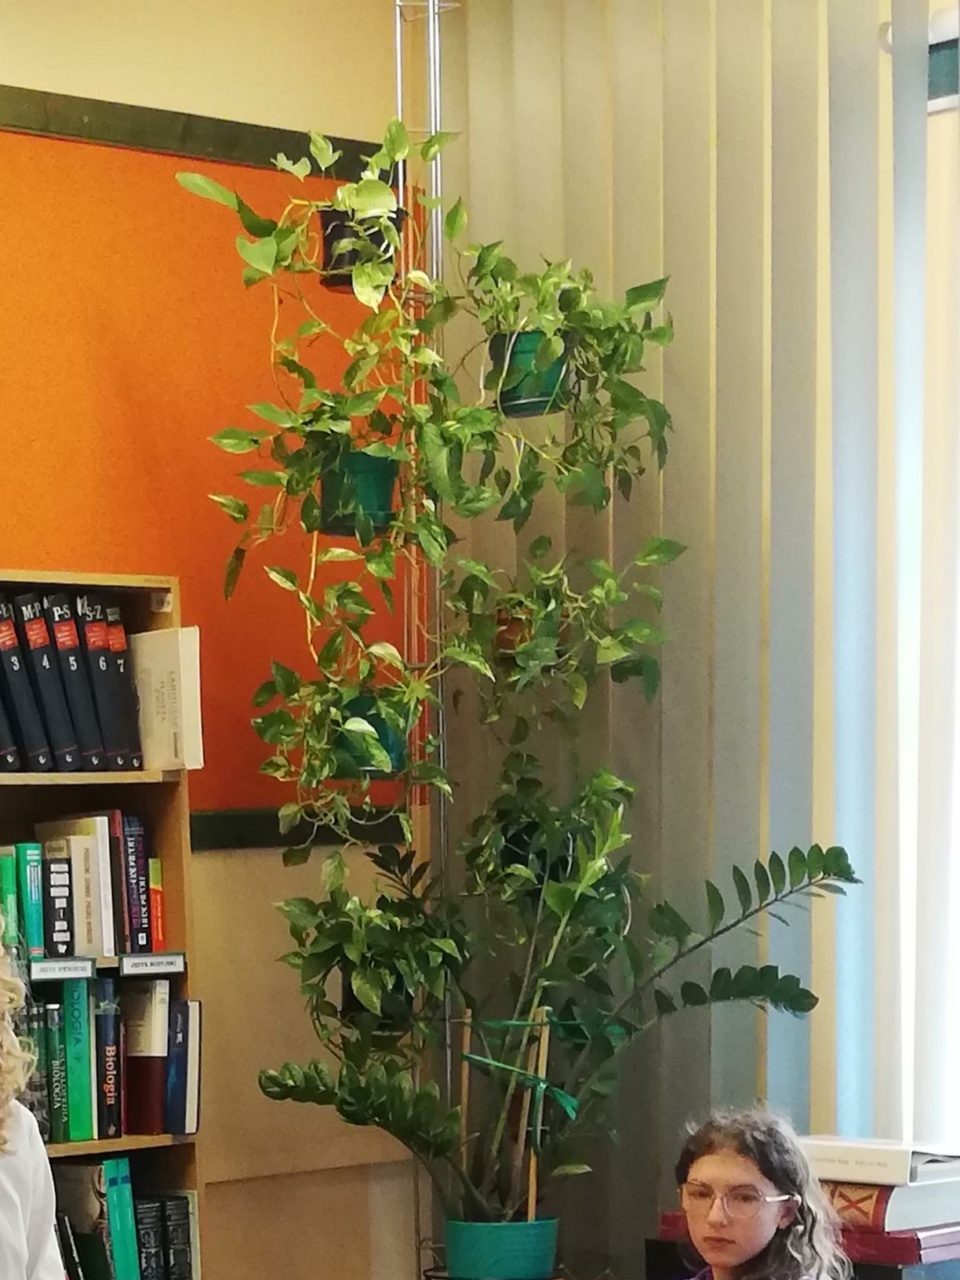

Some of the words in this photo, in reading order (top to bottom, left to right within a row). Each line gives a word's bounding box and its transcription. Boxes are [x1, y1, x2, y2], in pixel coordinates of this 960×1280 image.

[52, 604, 71, 622] P-S
[86, 605, 103, 621] S-Z
[10, 656, 20, 671] 3
[42, 654, 50, 669] 4
[68, 656, 78, 671] 5
[99, 656, 107, 671] 6
[117, 658, 125, 673] 7
[103, 1045, 118, 1106] Biologia
[51, 1059, 62, 1110] BIOLOGIA
